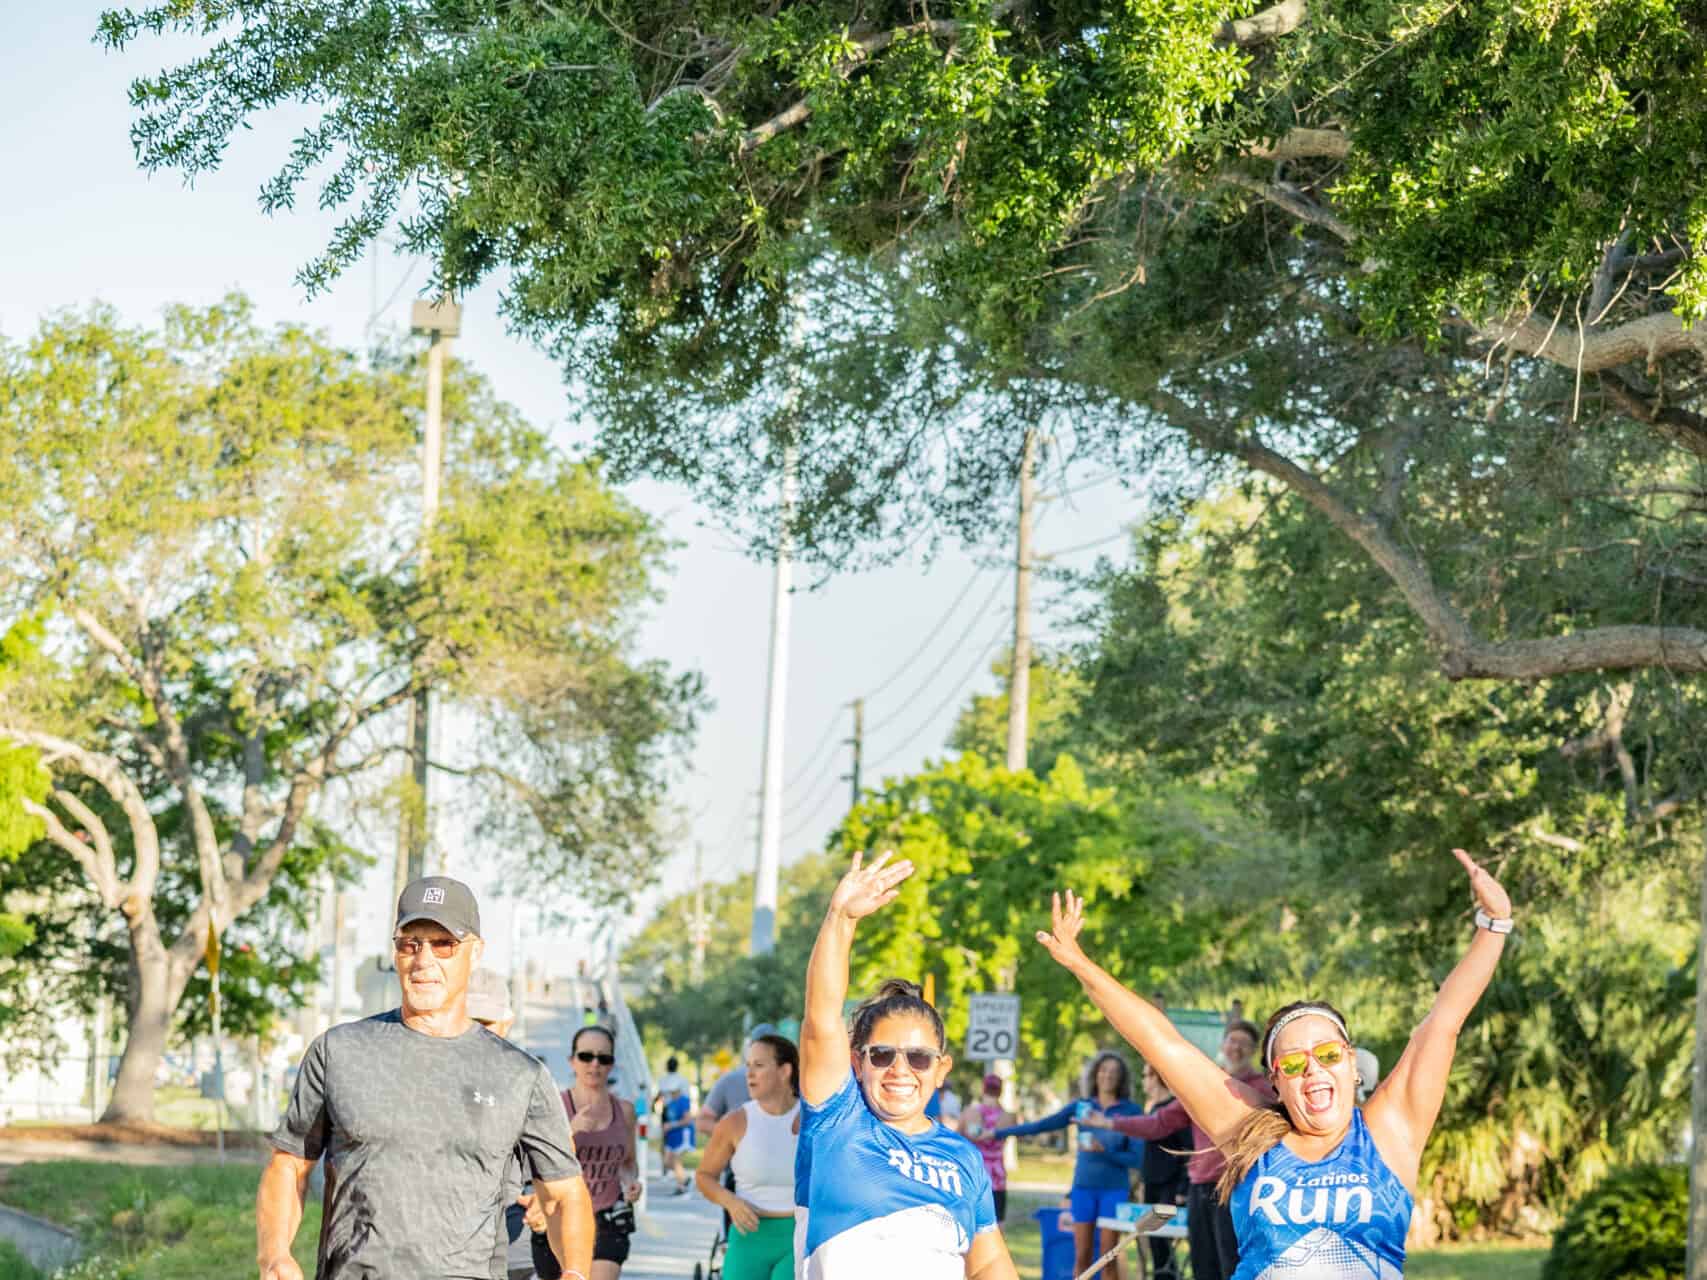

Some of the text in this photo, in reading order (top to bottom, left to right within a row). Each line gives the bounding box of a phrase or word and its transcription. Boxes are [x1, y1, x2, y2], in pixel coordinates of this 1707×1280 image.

[972, 1029, 1012, 1054] 20
[888, 1148, 963, 1197] Run
[1296, 1172, 1369, 1187] Latinos
[1249, 1175, 1373, 1225] Run
